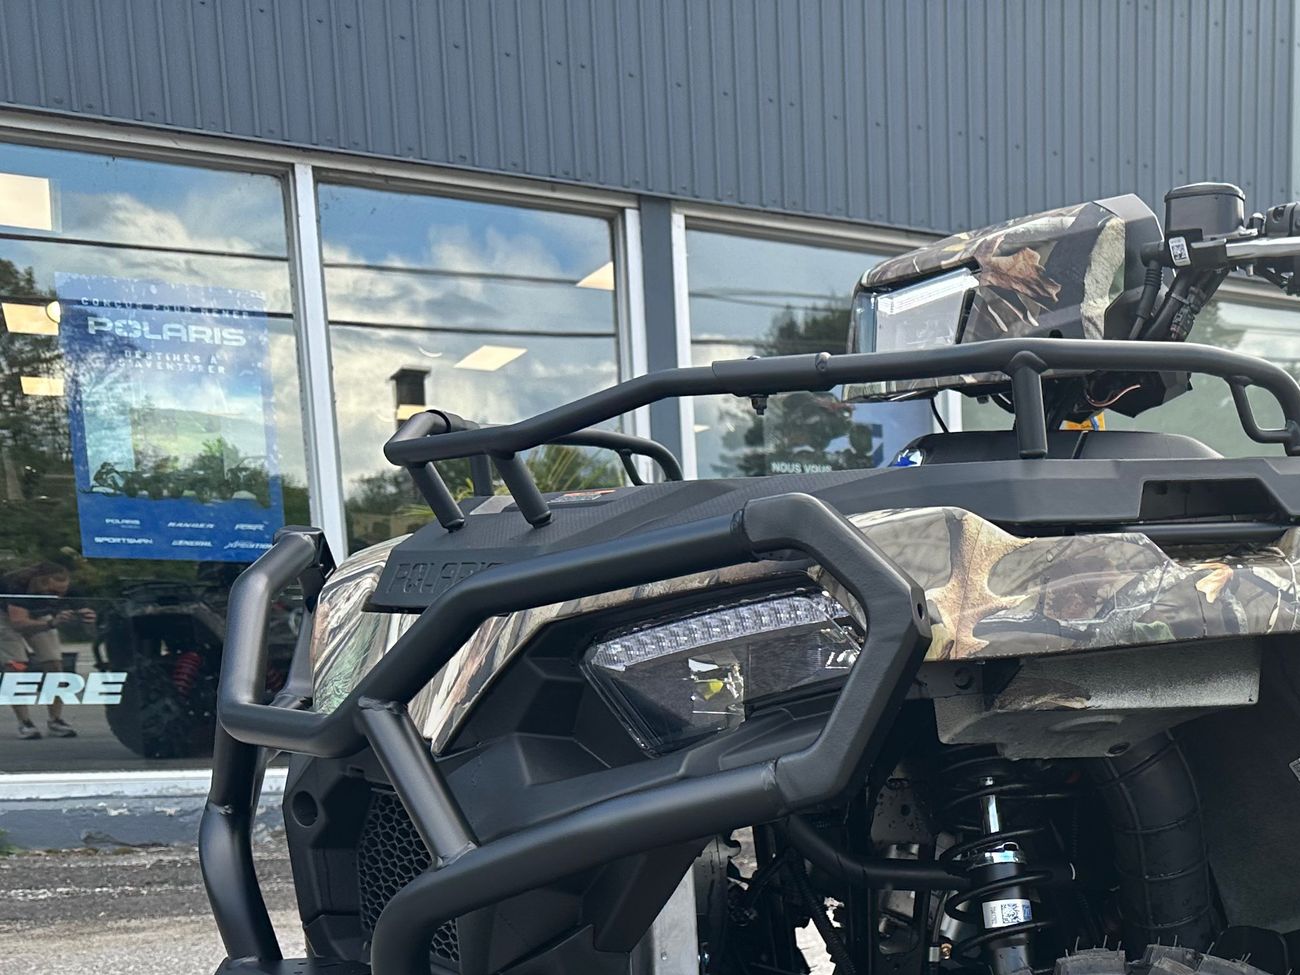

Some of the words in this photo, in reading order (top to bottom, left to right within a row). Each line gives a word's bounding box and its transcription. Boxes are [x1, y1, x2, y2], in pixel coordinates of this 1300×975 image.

[87, 315, 247, 347] POLARIS
[771, 461, 802, 473] NOUS
[94, 537, 154, 545] SPORTSMAN
[0, 672, 128, 705] ERE
